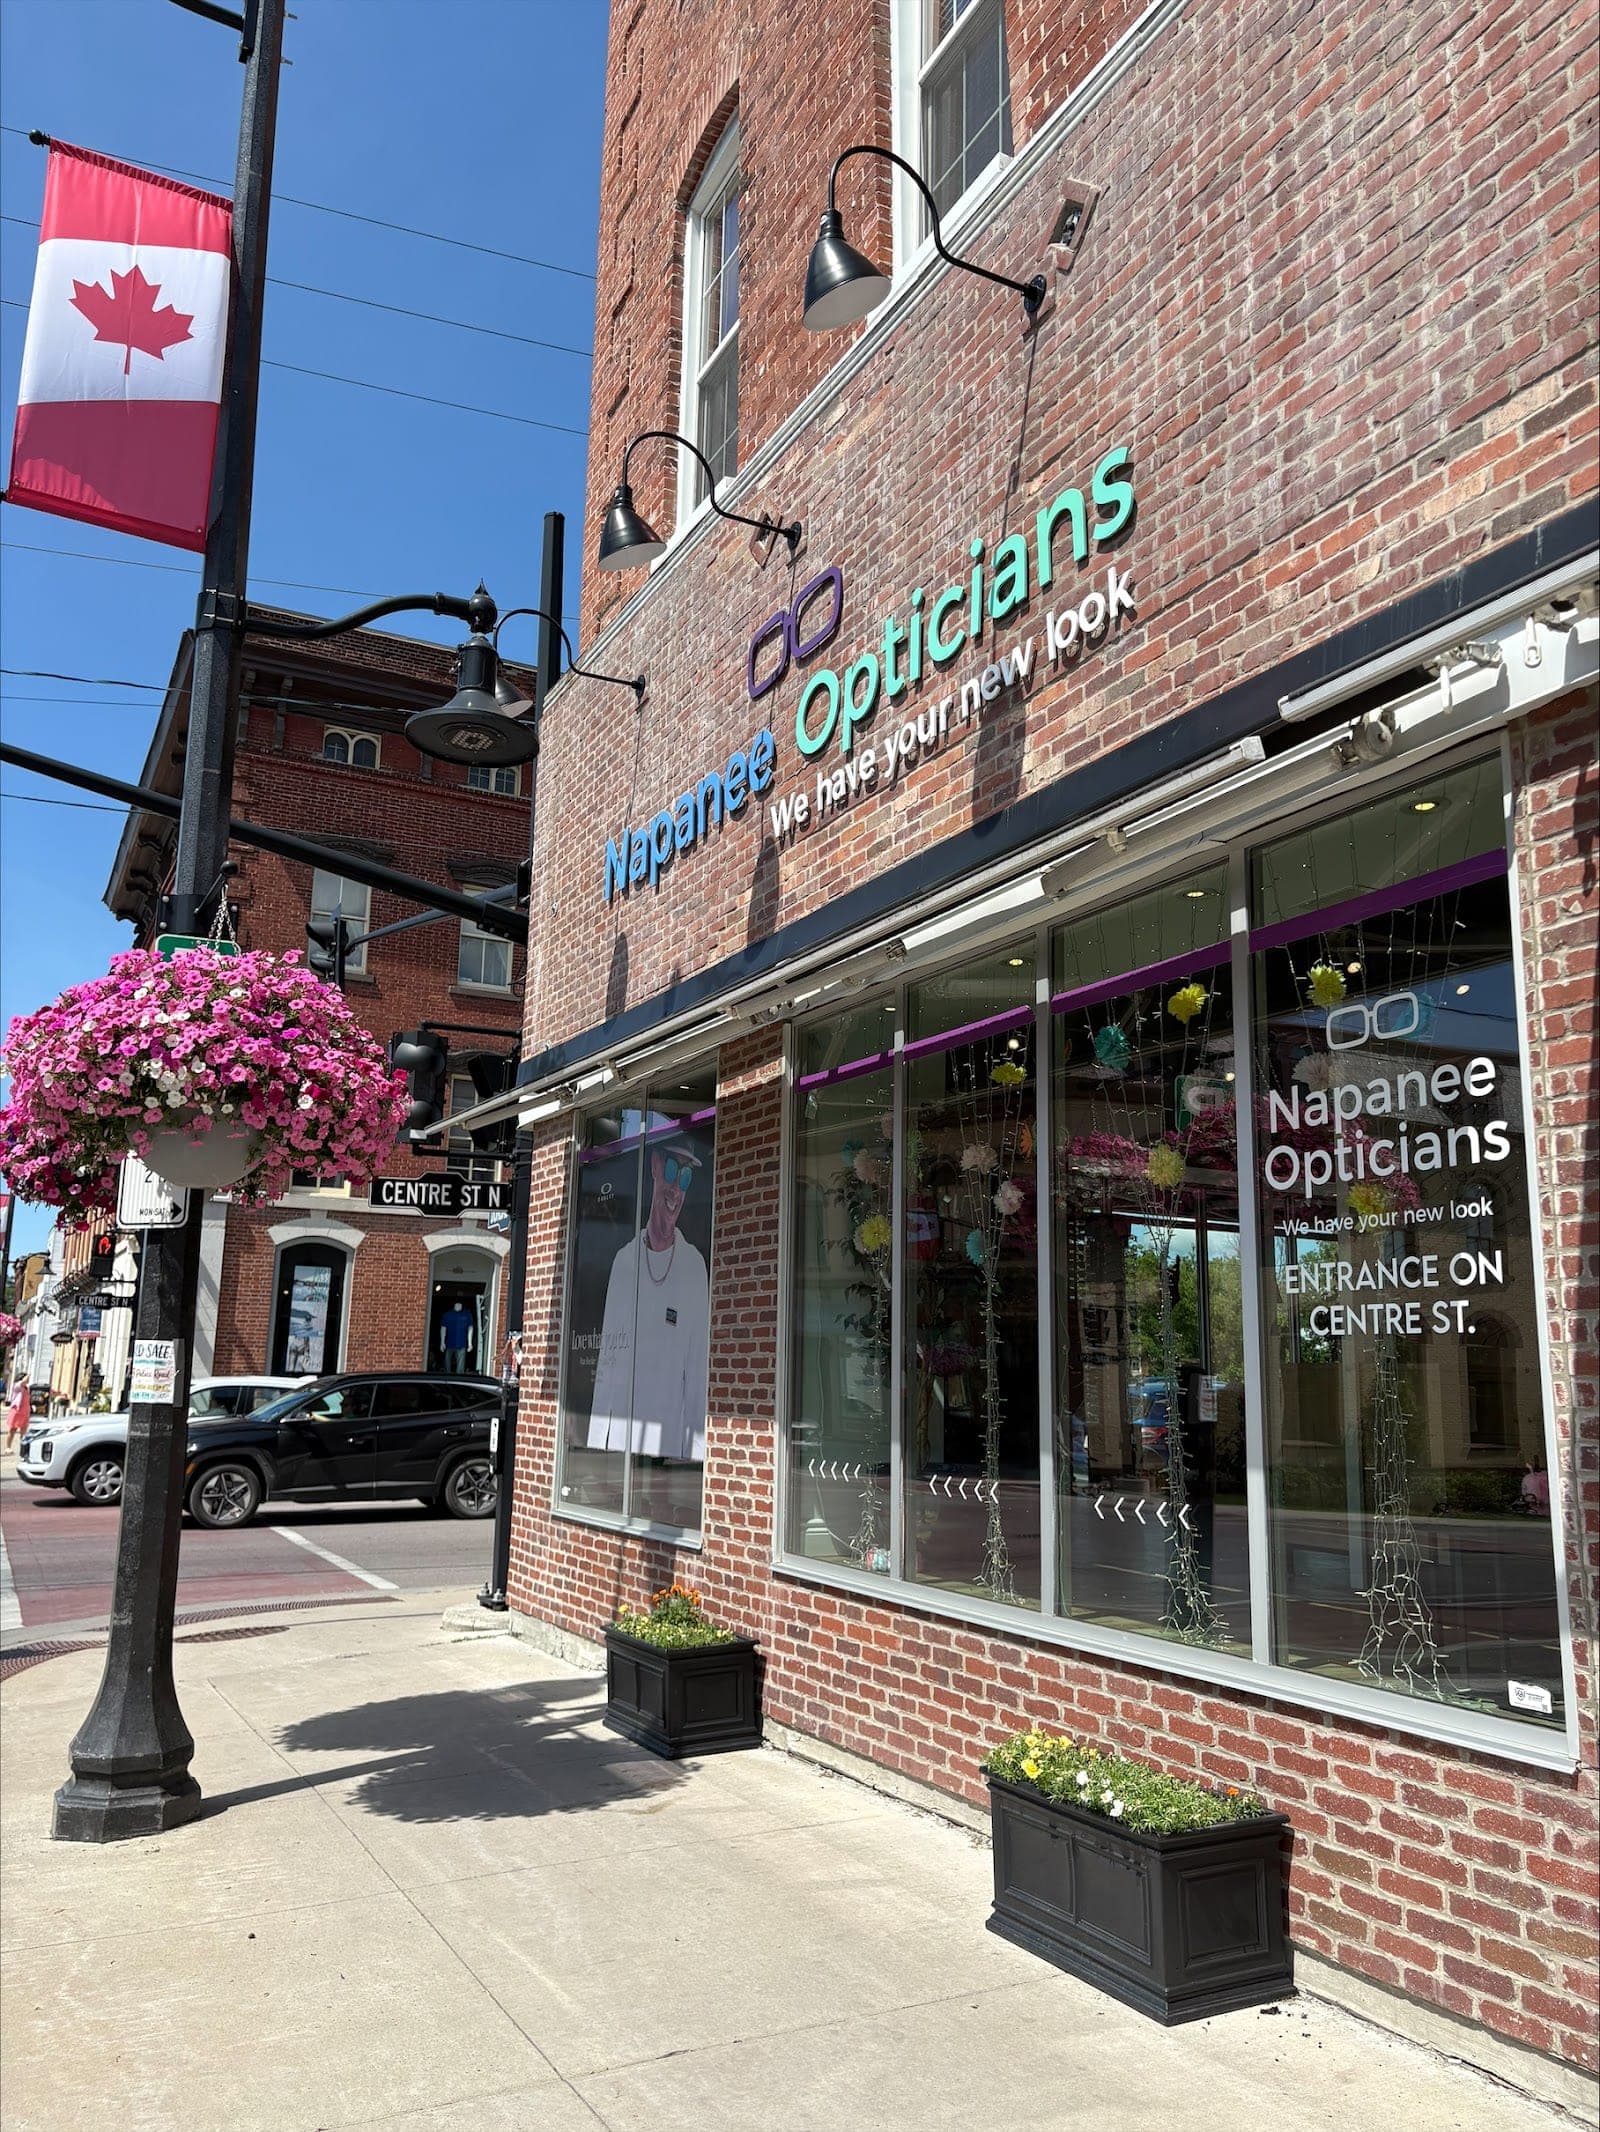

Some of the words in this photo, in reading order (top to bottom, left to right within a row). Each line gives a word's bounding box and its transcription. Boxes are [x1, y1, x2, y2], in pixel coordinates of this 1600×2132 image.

[795, 446, 1134, 755] Opticians
[770, 791, 809, 838] We
[816, 749, 876, 811] have
[884, 695, 953, 777] your
[961, 636, 1034, 718] new
[1046, 566, 1136, 660] look
[604, 728, 777, 901] Napanee
[1268, 1056, 1496, 1135] Napanee
[1264, 1120, 1512, 1199] Opticians
[382, 1181, 452, 1206] CENTRE
[460, 1185, 481, 1207] ST
[488, 1185, 501, 1208] N
[1282, 1219, 1309, 1236] We
[1314, 1215, 1354, 1234] have
[1359, 1209, 1398, 1234] your
[1404, 1204, 1444, 1225] new
[1450, 1196, 1494, 1219] look
[1285, 1254, 1439, 1294] ENTRANCE
[1450, 1250, 1504, 1286] ON
[79, 1296, 109, 1306] CENTRE
[111, 1298, 119, 1306] ST
[121, 1298, 129, 1307] N
[1309, 1302, 1422, 1337] CENTRE
[1432, 1300, 1476, 1335] ST.
[146, 1343, 171, 1359] SALE
